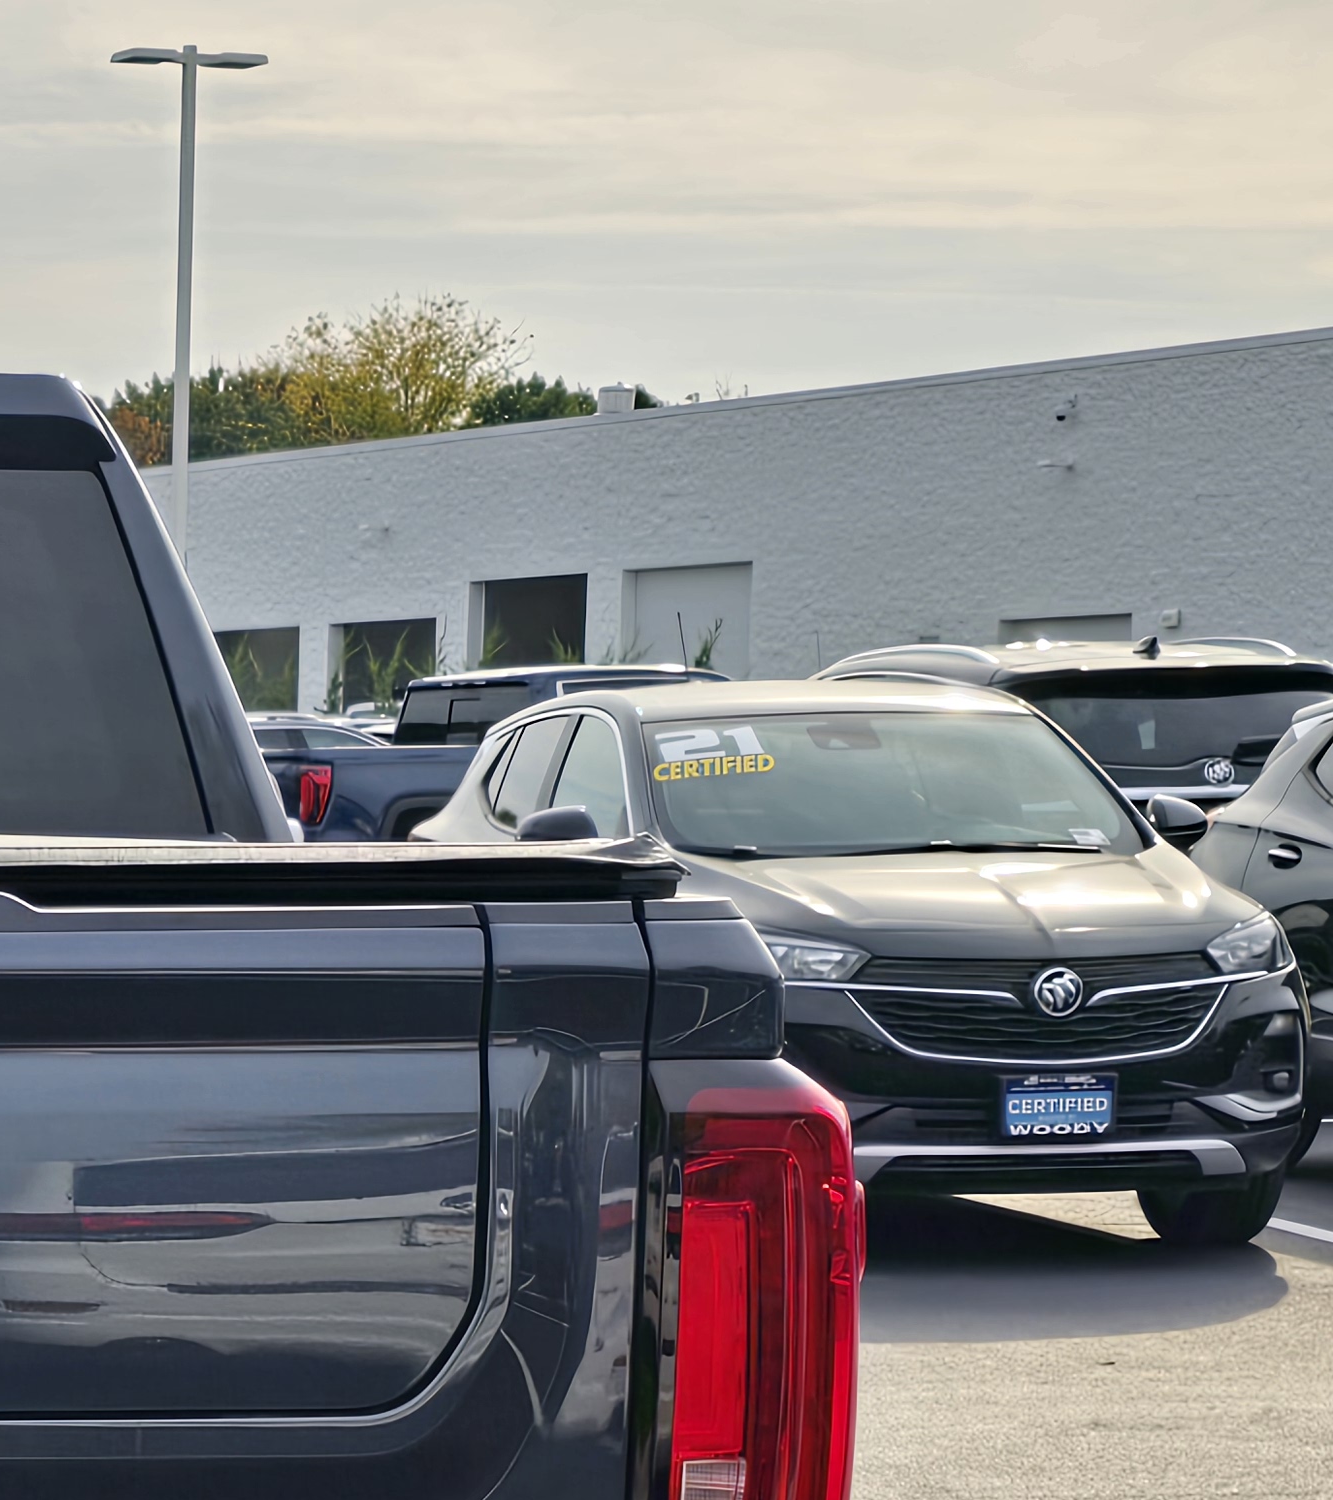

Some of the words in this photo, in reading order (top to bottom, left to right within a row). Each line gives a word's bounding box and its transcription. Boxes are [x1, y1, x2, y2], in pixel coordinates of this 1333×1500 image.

[654, 726, 765, 762] 21
[653, 754, 776, 782] CERTIFIED
[1008, 1098, 1108, 1114] CERTIFIED
[1009, 1121, 1109, 1136] WOODY
